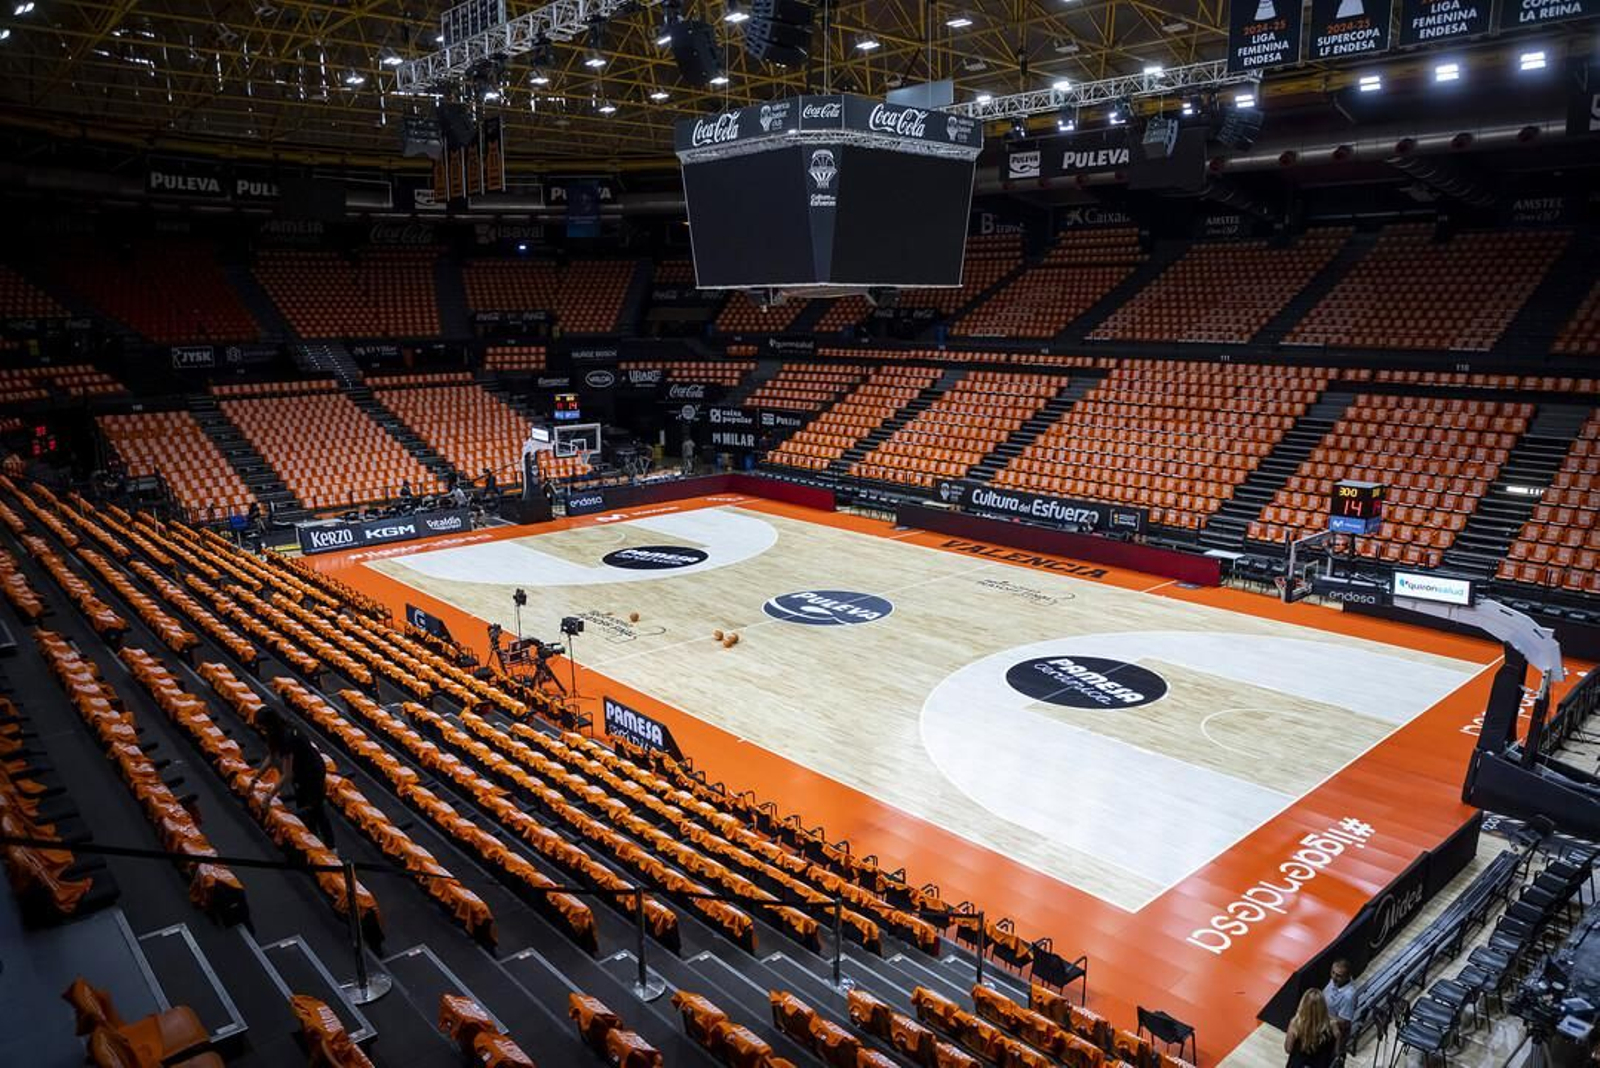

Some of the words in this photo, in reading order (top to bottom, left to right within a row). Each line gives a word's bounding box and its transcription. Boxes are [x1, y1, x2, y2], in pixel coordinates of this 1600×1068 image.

[1430, 0, 1461, 14] LIGA
[1519, 10, 1536, 22] LA
[1540, 2, 1582, 19] REINA
[1412, 7, 1478, 29] FEMENINA
[1252, 32, 1276, 44] LIGA
[1317, 27, 1381, 47] SUPERCOPA
[1419, 21, 1468, 39] ENDESA
[1237, 40, 1289, 57] FEMENINA
[1319, 46, 1331, 57] LF
[1333, 40, 1376, 55] ENDESA
[1243, 52, 1282, 67] ENDESA
[1061, 148, 1130, 170] PULEVA
[150, 171, 221, 193] PULEVA
[182, 350, 211, 362] JYSK
[569, 496, 603, 508] endesa
[971, 488, 1019, 511] Cultura
[1019, 503, 1031, 513] del
[1031, 499, 1100, 525] Esfuerzo
[1343, 499, 1363, 517] 14
[365, 524, 416, 540] KGM
[940, 540, 1110, 579] VALENCIA
[791, 592, 882, 621] PULEVA
[1329, 590, 1376, 605] endesa
[1046, 658, 1145, 703] PAMESA
[605, 701, 664, 747] PAMESA
[1186, 817, 1376, 955] #ligaendesa
